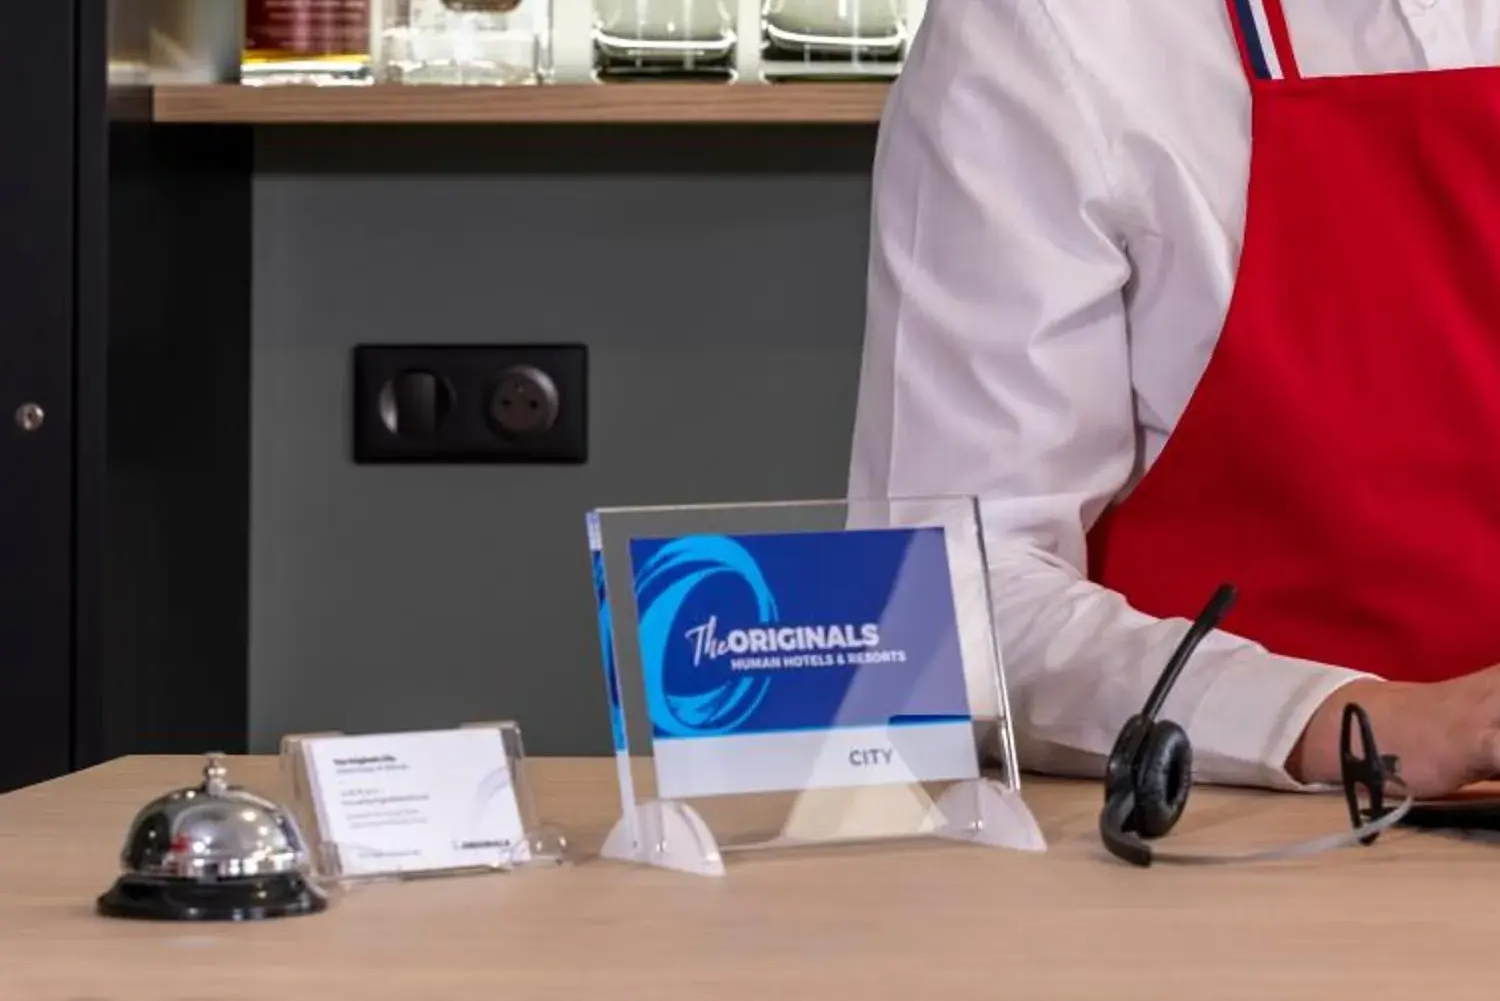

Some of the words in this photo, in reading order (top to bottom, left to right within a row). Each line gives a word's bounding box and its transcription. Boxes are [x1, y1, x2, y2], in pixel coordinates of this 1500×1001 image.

[727, 622, 880, 654] ORIGINALS
[730, 655, 782, 671] HUMAN
[783, 653, 834, 670] HOTELS
[836, 653, 847, 666] &
[848, 649, 908, 665] RESORTS
[849, 747, 893, 767] CITY
